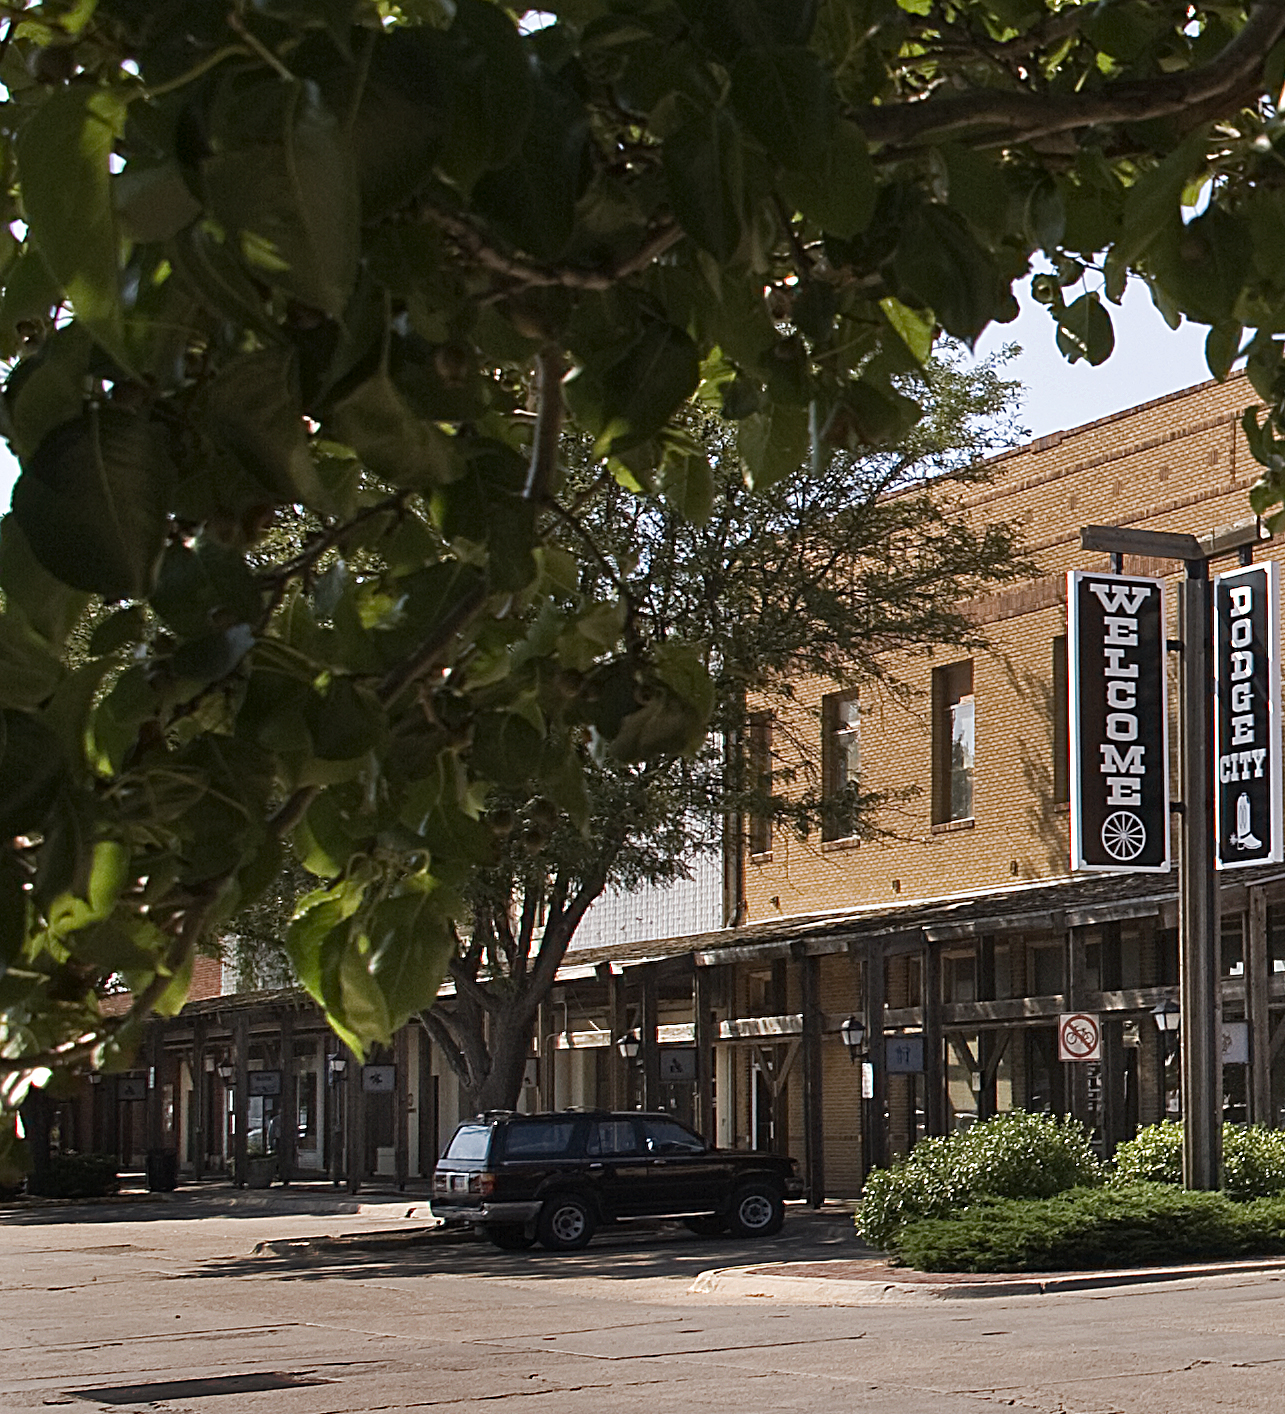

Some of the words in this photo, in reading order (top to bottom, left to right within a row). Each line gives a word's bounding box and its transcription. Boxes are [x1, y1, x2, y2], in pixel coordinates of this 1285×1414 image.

[1089, 583, 1151, 806] WELCOME
[1229, 585, 1255, 746] DODGE
[1219, 747, 1267, 784] CITY
